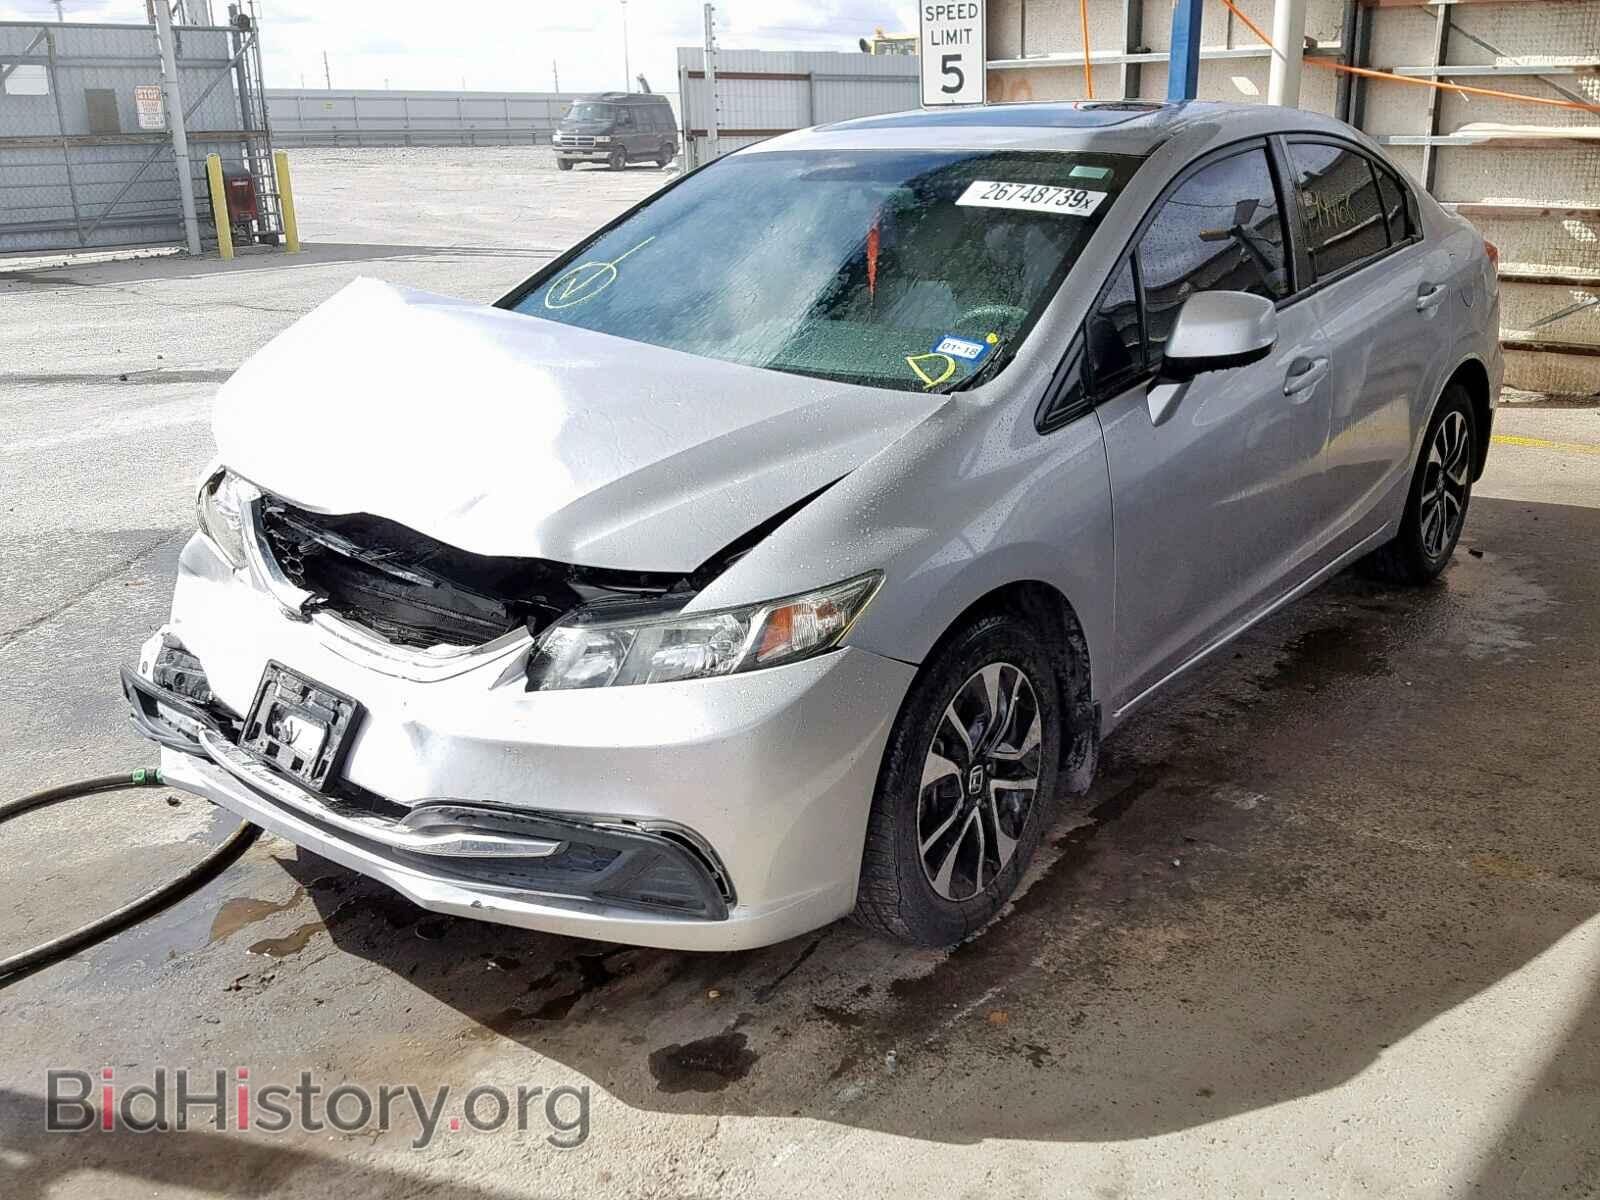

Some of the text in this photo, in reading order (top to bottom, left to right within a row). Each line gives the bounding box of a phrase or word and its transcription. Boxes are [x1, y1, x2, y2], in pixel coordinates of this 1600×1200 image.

[925, 3, 978, 21] SPEED
[931, 28, 972, 45] LIMIT
[941, 54, 964, 94] 5
